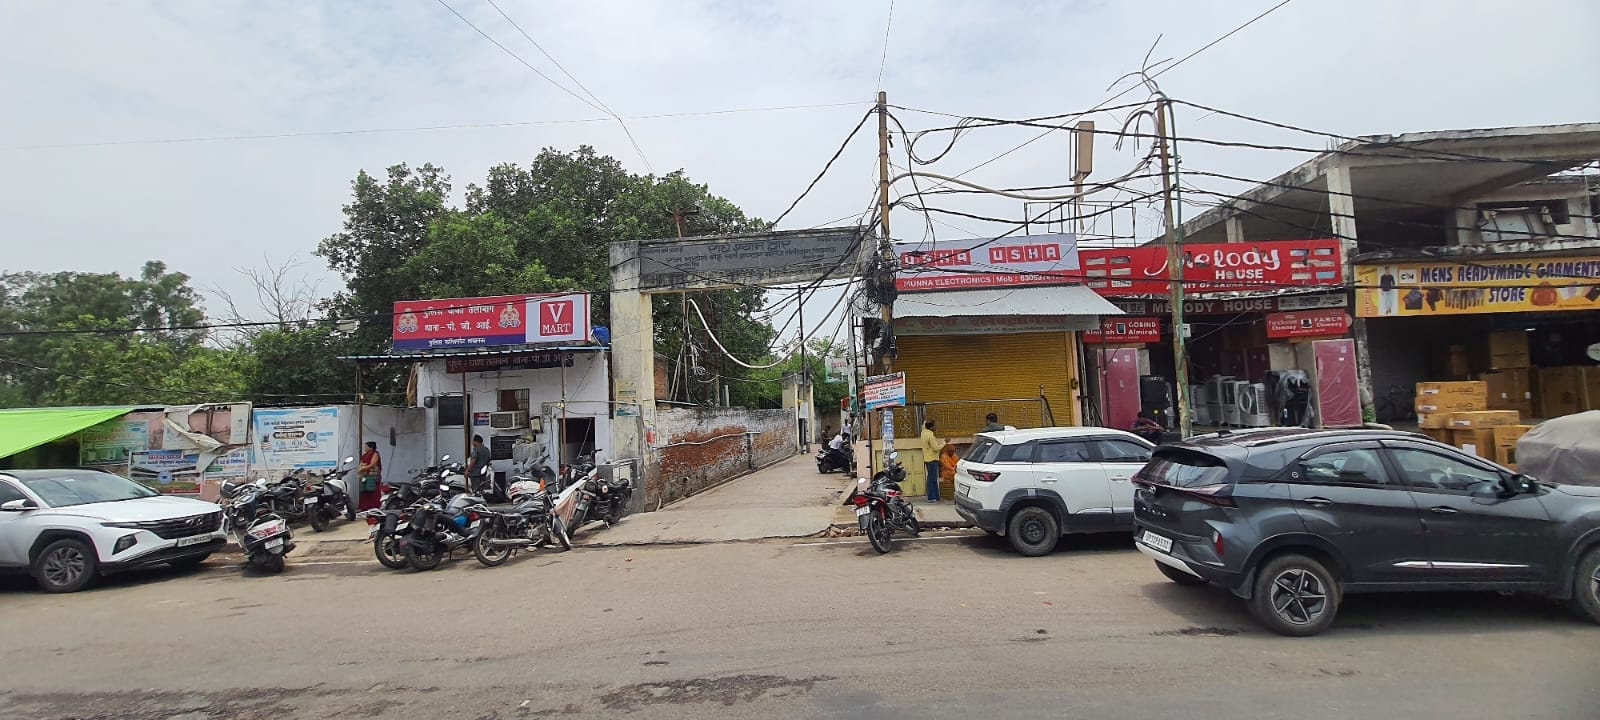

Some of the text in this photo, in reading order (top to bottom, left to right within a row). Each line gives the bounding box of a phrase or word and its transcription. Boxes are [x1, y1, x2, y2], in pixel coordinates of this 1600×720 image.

[904, 250, 968, 265] USHA
[993, 246, 1056, 260] USHA
[1421, 260, 1600, 283] MENS READYMADE GARMENTS
[904, 275, 991, 288] MUNNA ELECTRONICS
[997, 275, 1013, 283] Mob
[1489, 287, 1525, 303] STORE
[548, 303, 566, 323] V
[1152, 302, 1214, 313] MEODY
[1224, 299, 1272, 312] HOUSE
[542, 323, 571, 334] MART
